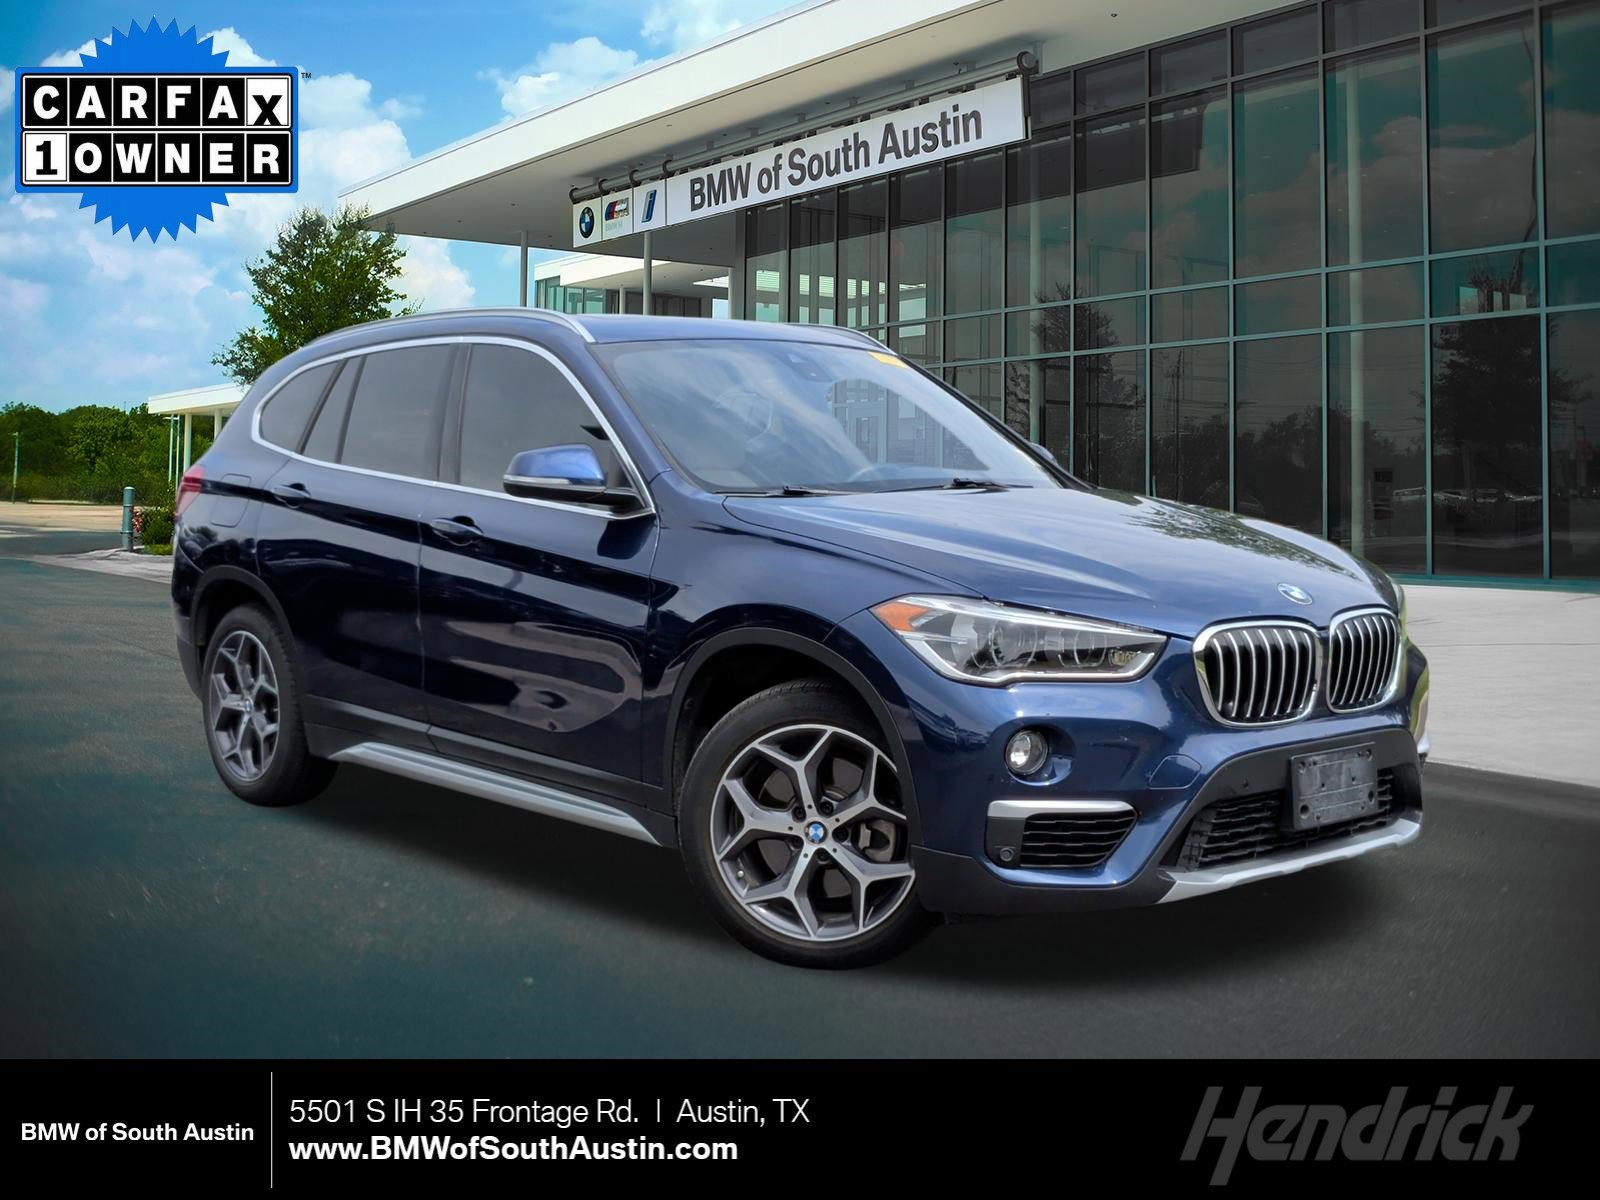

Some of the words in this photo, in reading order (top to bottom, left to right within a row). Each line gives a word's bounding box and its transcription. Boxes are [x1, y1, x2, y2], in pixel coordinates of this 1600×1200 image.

[690, 162, 751, 212] BMW
[757, 153, 783, 194] of
[788, 132, 871, 186] South
[878, 104, 982, 163] Austin
